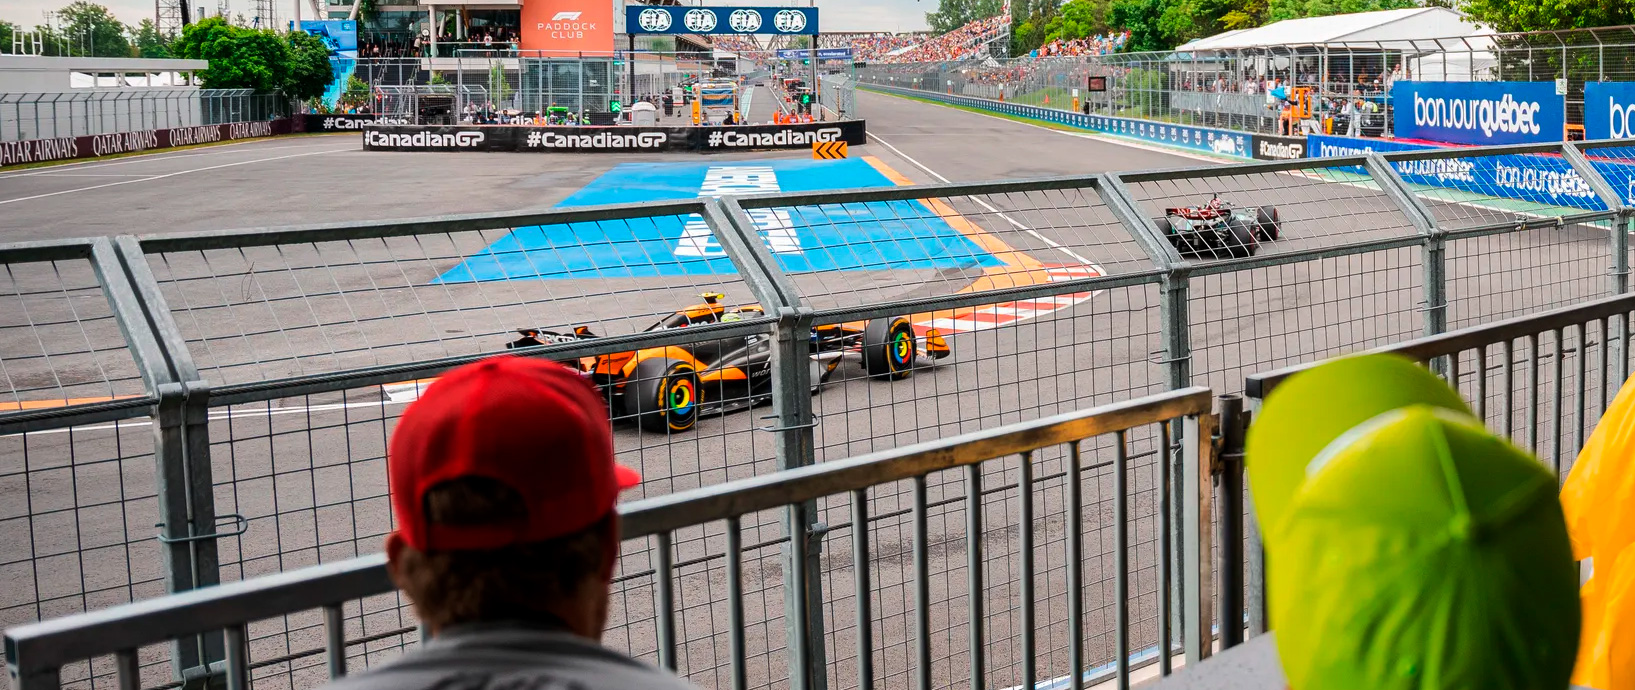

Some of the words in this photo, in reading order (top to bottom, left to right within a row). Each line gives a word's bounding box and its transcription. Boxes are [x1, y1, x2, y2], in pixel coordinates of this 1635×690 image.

[537, 22, 596, 31] PADDOCK
[551, 31, 584, 39] CLUB
[169, 128, 193, 147] QATAR
[193, 125, 221, 143] AIRWAYS
[229, 123, 250, 140] QATAR
[250, 120, 272, 138] AIRWAYS
[364, 130, 485, 147] #CanadianGP
[708, 127, 842, 147] #CanadianGP
[93, 134, 123, 157] QATAR
[124, 130, 158, 151] AIRWAYS
[527, 131, 667, 148] #CanadianGP
[1259, 138, 1303, 151] #CanadianGP
[0, 141, 32, 166] ATAR
[35, 137, 78, 161] AIRWAYS
